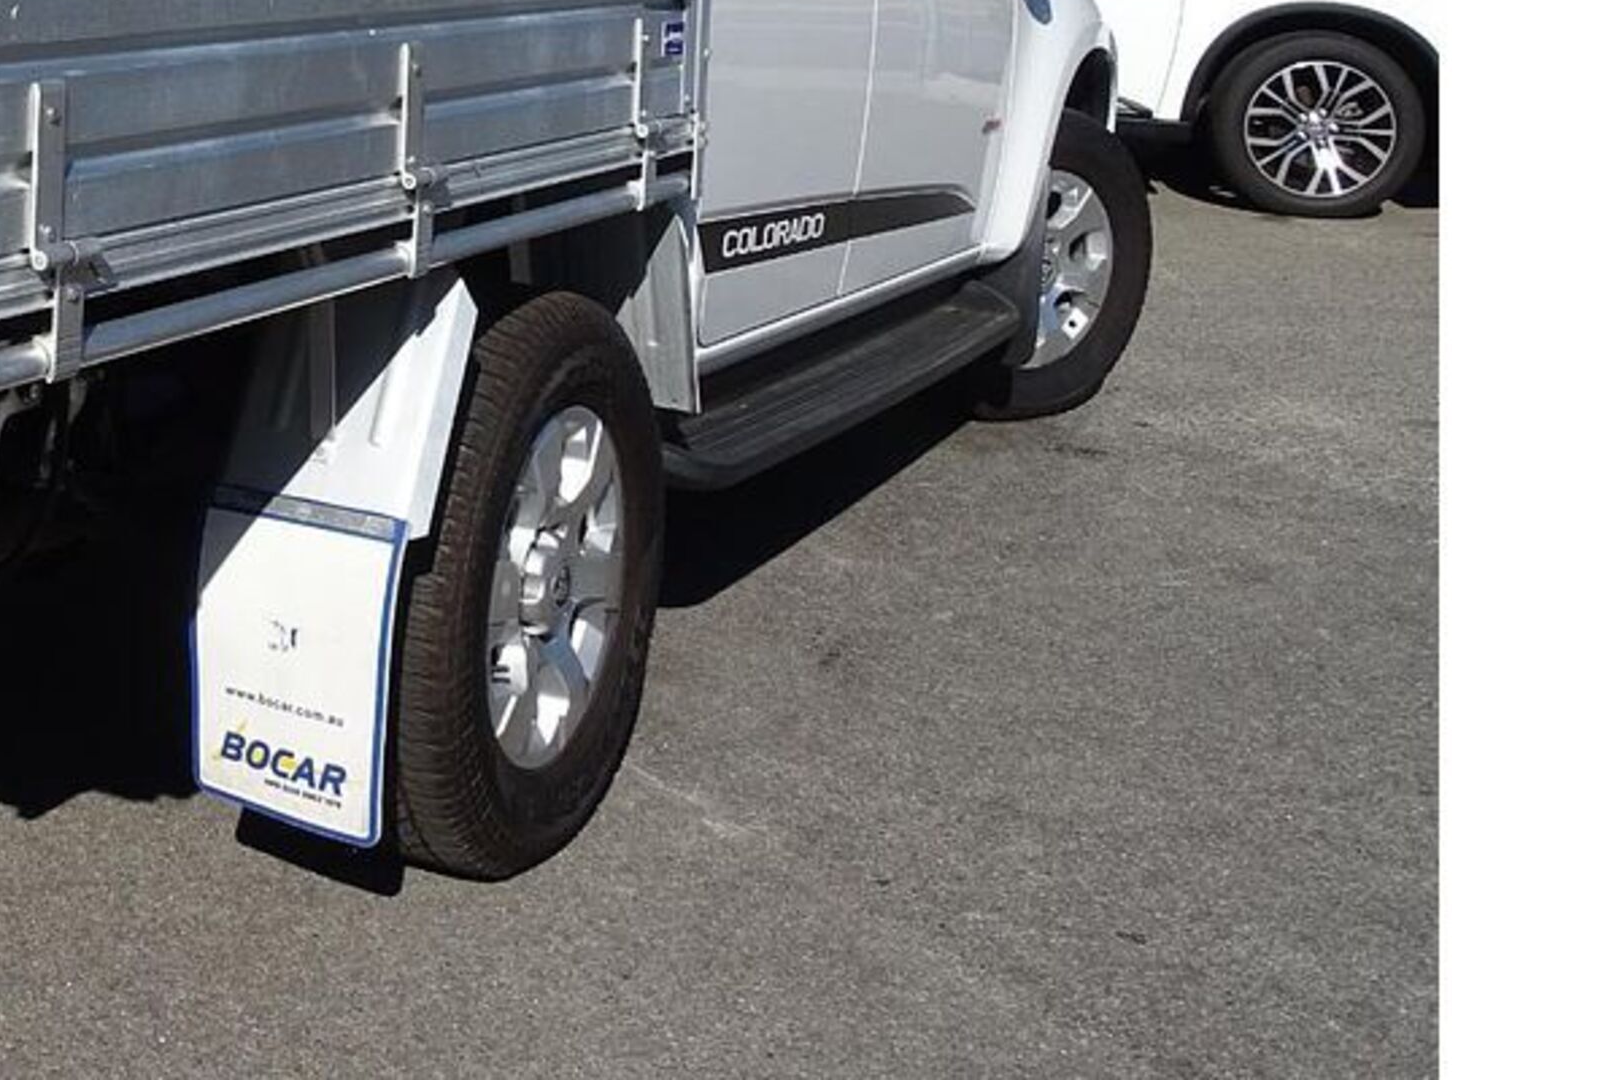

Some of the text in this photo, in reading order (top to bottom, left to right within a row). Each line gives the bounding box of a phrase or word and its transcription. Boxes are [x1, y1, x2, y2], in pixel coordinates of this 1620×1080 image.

[722, 212, 826, 258] COLORADO
[225, 686, 345, 728] www.bocar.com.au
[220, 731, 347, 796] BOCAR
